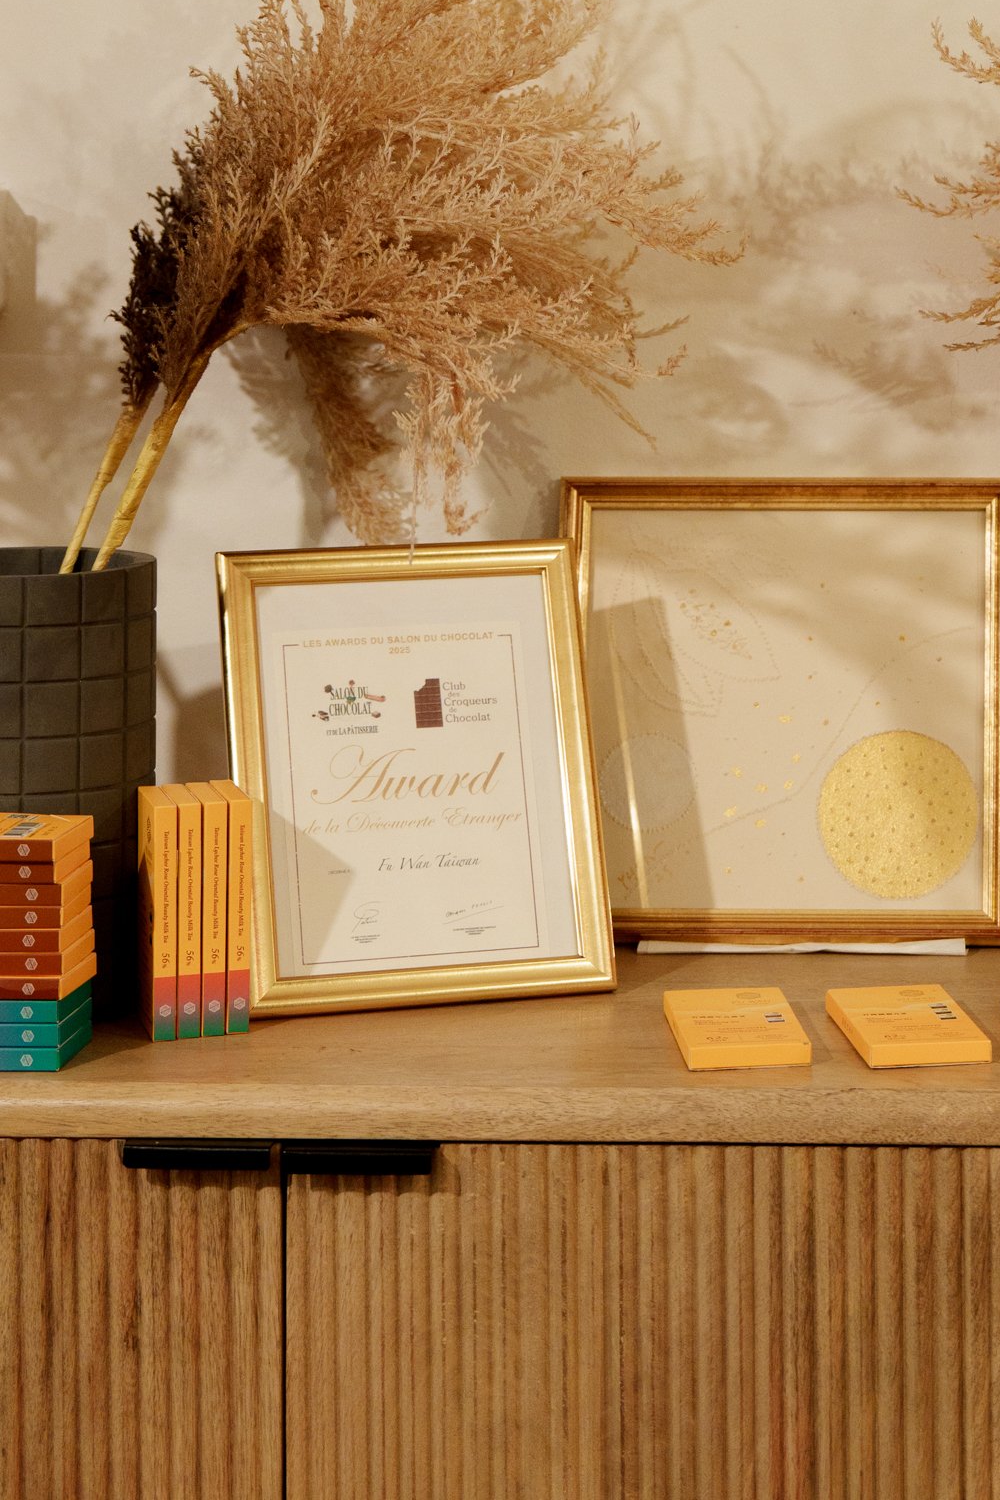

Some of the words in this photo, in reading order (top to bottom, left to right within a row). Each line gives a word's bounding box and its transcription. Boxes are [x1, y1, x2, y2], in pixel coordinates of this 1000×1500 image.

[303, 640, 322, 648] LES
[325, 638, 367, 647] AWARDS
[370, 637, 384, 645] DU
[387, 635, 420, 644] SALON
[424, 634, 438, 642] DU
[440, 631, 494, 642] CHOCOLAT
[330, 687, 356, 700] SALON
[358, 686, 369, 698] DU
[442, 681, 466, 691] Club
[329, 702, 372, 717] CHOCOLAT
[443, 697, 498, 708] Croqueurs
[445, 713, 491, 723] Chocolat
[338, 727, 347, 736] LA
[310, 745, 505, 805] Award
[302, 819, 320, 835] de
[325, 817, 340, 833] la
[378, 857, 393, 872] Fu
[400, 854, 432, 870] Wan
[435, 852, 481, 868] Taiwan
[212, 917, 220, 930] Milk
